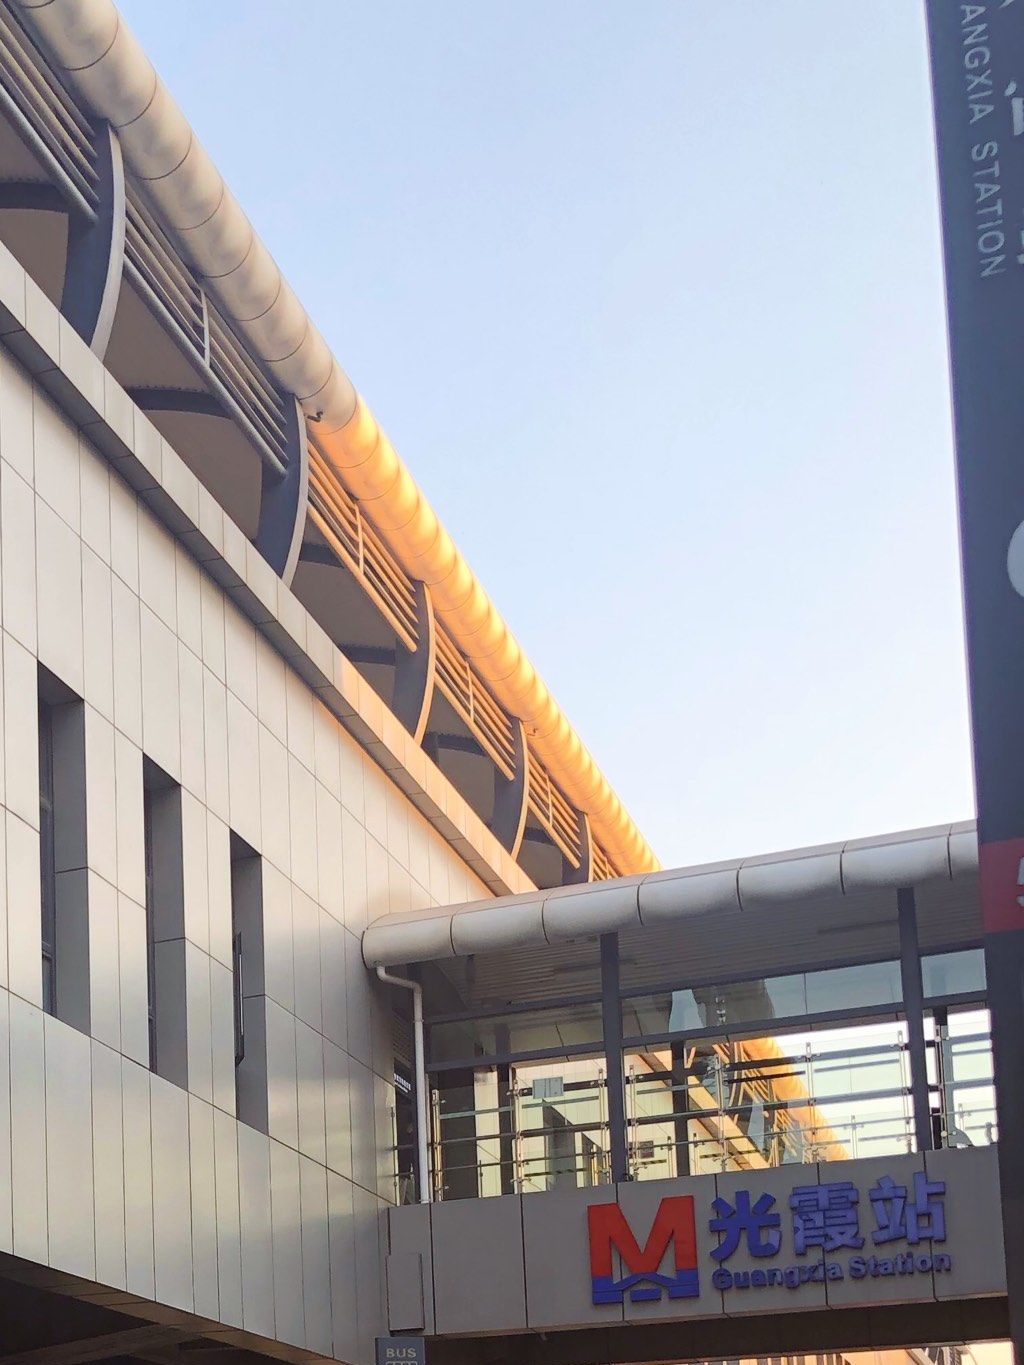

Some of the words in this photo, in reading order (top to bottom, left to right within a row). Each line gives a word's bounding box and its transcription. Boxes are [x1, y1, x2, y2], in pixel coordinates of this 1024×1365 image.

[971, 141, 1006, 277] STATION
[709, 1172, 946, 1262] 光霞站
[712, 1259, 844, 1290] Guangxia
[848, 1250, 952, 1279] Station
[386, 1347, 416, 1358] BUS
